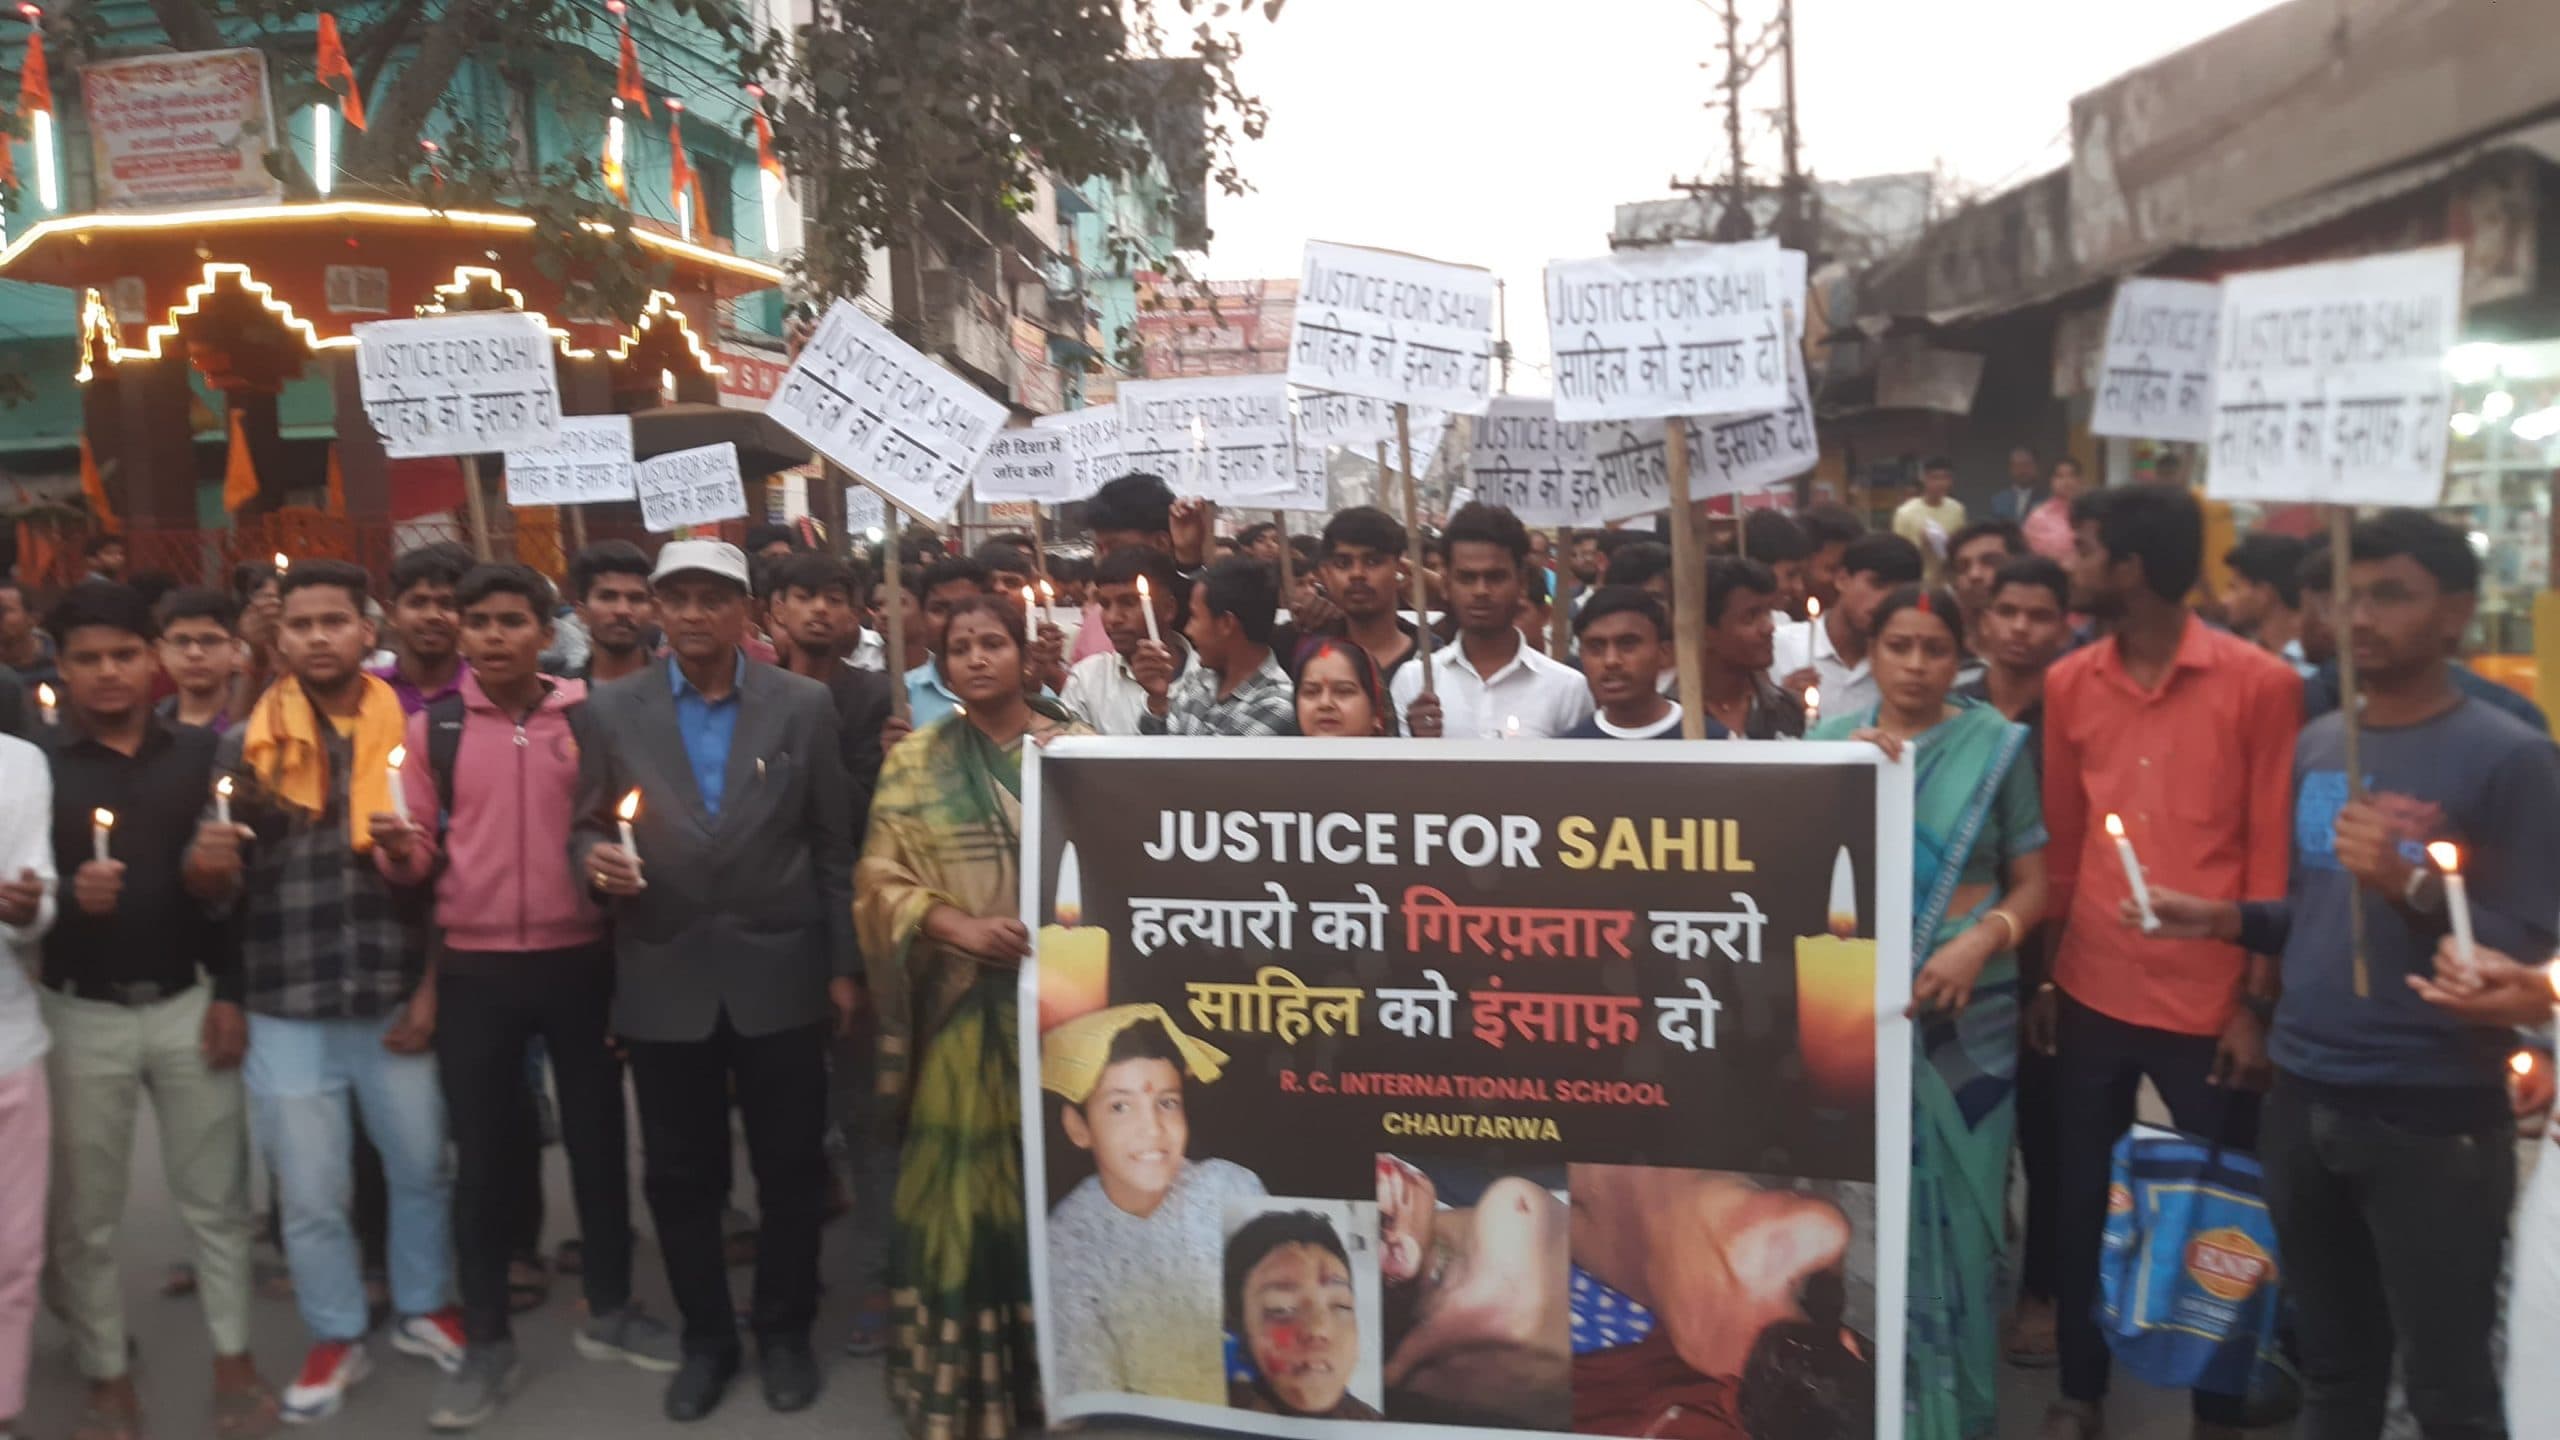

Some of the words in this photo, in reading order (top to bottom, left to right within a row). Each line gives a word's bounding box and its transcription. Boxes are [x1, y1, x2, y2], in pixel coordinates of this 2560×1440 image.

[1303, 257, 1384, 315] JUSTICE
[1390, 280, 1433, 321] FOR
[1436, 290, 1493, 334] SAHIL
[1555, 276, 1647, 326] JUSTICE
[1651, 277, 1701, 319] FOR
[1703, 269, 1773, 317] SAHIL
[1296, 311, 1363, 377] साहिल
[1368, 322, 1397, 379] को
[2112, 302, 2196, 352] JUSTICE
[2226, 304, 2312, 371] JUSTICE
[364, 342, 442, 381] JUSTICE
[445, 338, 488, 376] FOR
[488, 335, 548, 373] SAHIL
[813, 314, 898, 396] JUSTICE
[886, 369, 936, 418] FOR
[926, 395, 988, 455] SAHIL
[1556, 330, 1629, 404] साहिल
[1638, 327, 1669, 392] को
[1755, 317, 1780, 386] दो
[435, 381, 464, 434] को
[1125, 396, 1192, 433] JUSTICE
[1232, 395, 1287, 427] SAHIL
[1473, 415, 1549, 449] JUSTICE
[1782, 390, 1808, 454] दो
[1012, 437, 1047, 457] दिशा
[1538, 455, 1565, 509] को
[1143, 809, 1399, 866] JUSTICE
[1413, 813, 1542, 869] FOR
[1556, 816, 1756, 872] SAHIL
[1127, 881, 1297, 958] हत्यारो
[1309, 883, 1389, 952] को
[1647, 892, 1769, 964] करो
[1185, 966, 1365, 1044] साहिल
[1375, 969, 1458, 1039] को
[1469, 975, 1642, 1050] इंसाफ़
[1654, 979, 1723, 1051] दो
[1280, 1069, 1305, 1094] R.
[1308, 1070, 1336, 1095] C.
[1340, 1071, 1552, 1102] INTERNATIONAL
[1554, 1079, 1670, 1107] SCHOOL
[1382, 1111, 1561, 1143] CHAUTARWA
